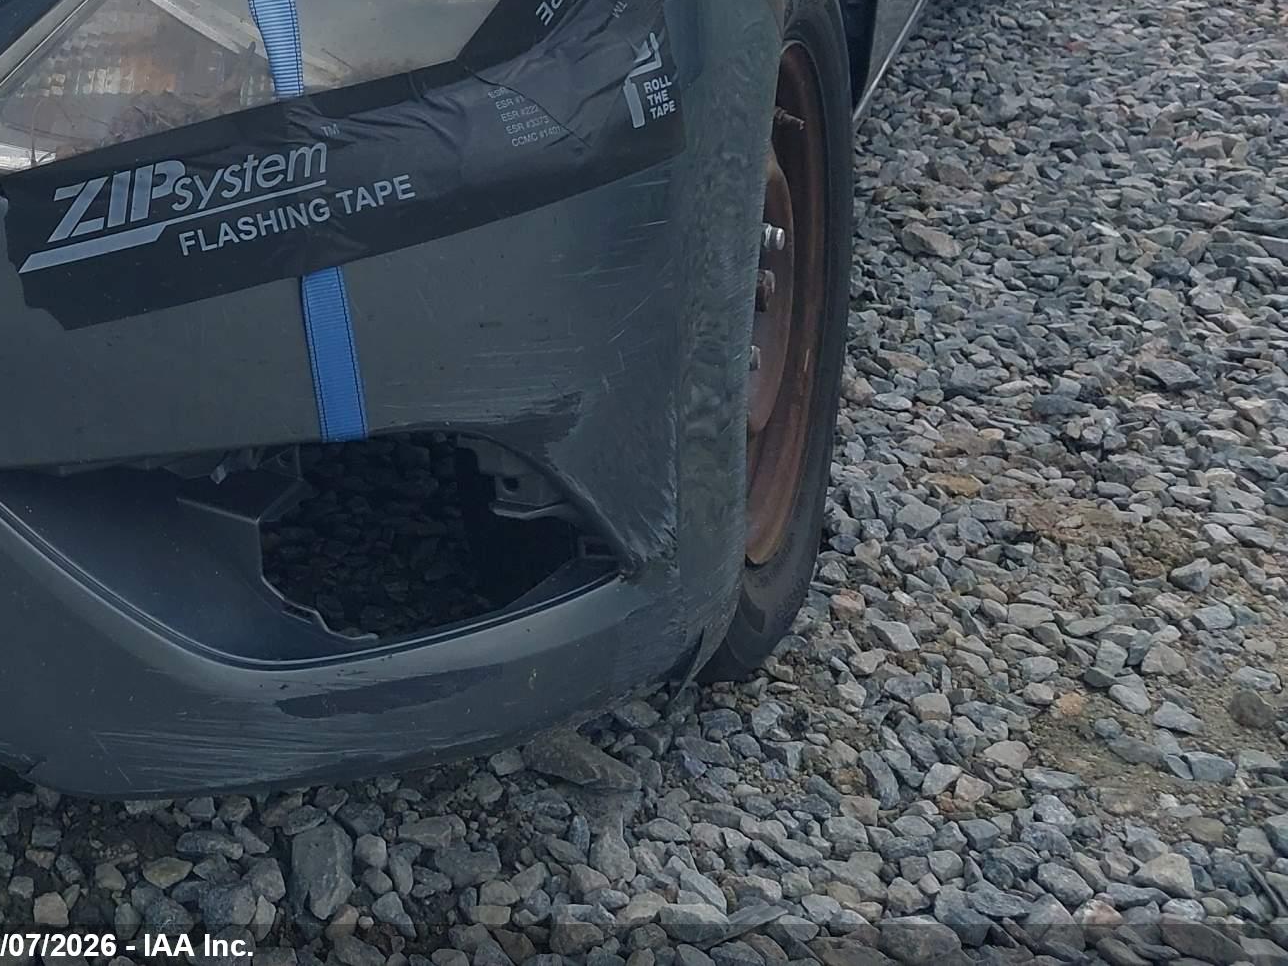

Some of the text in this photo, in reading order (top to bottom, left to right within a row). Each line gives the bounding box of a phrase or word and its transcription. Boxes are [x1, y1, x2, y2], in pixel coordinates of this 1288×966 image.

[643, 75, 673, 94] ROLL
[647, 90, 669, 106] THE
[650, 100, 676, 120] TAPE
[511, 133, 538, 147] CCMC
[178, 174, 416, 256] FLASHING TAPE
